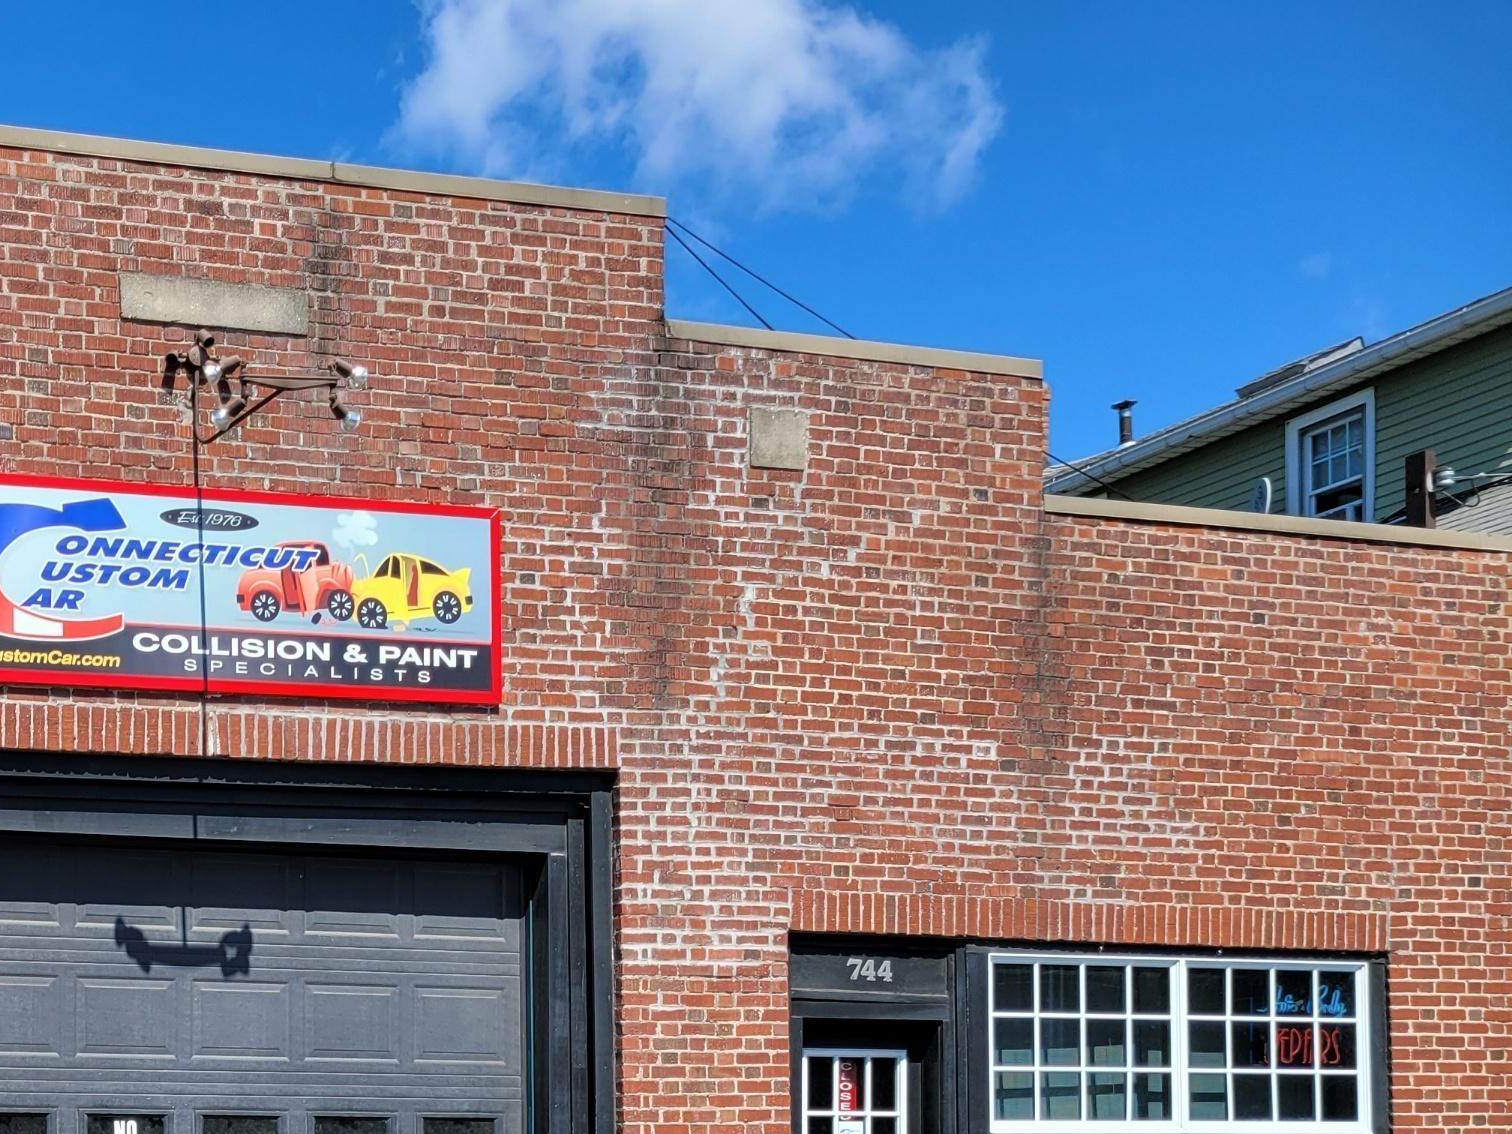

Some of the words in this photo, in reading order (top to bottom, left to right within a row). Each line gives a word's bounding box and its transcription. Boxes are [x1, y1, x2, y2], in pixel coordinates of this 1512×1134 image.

[206, 513, 242, 527] 1976
[40, 561, 189, 589] USTOM
[20, 588, 85, 610] AR
[132, 632, 330, 662] COLLISION
[343, 644, 368, 664] &
[379, 645, 478, 669] PAINT
[184, 659, 431, 683] SPECIALISTS
[846, 957, 893, 982] 744
